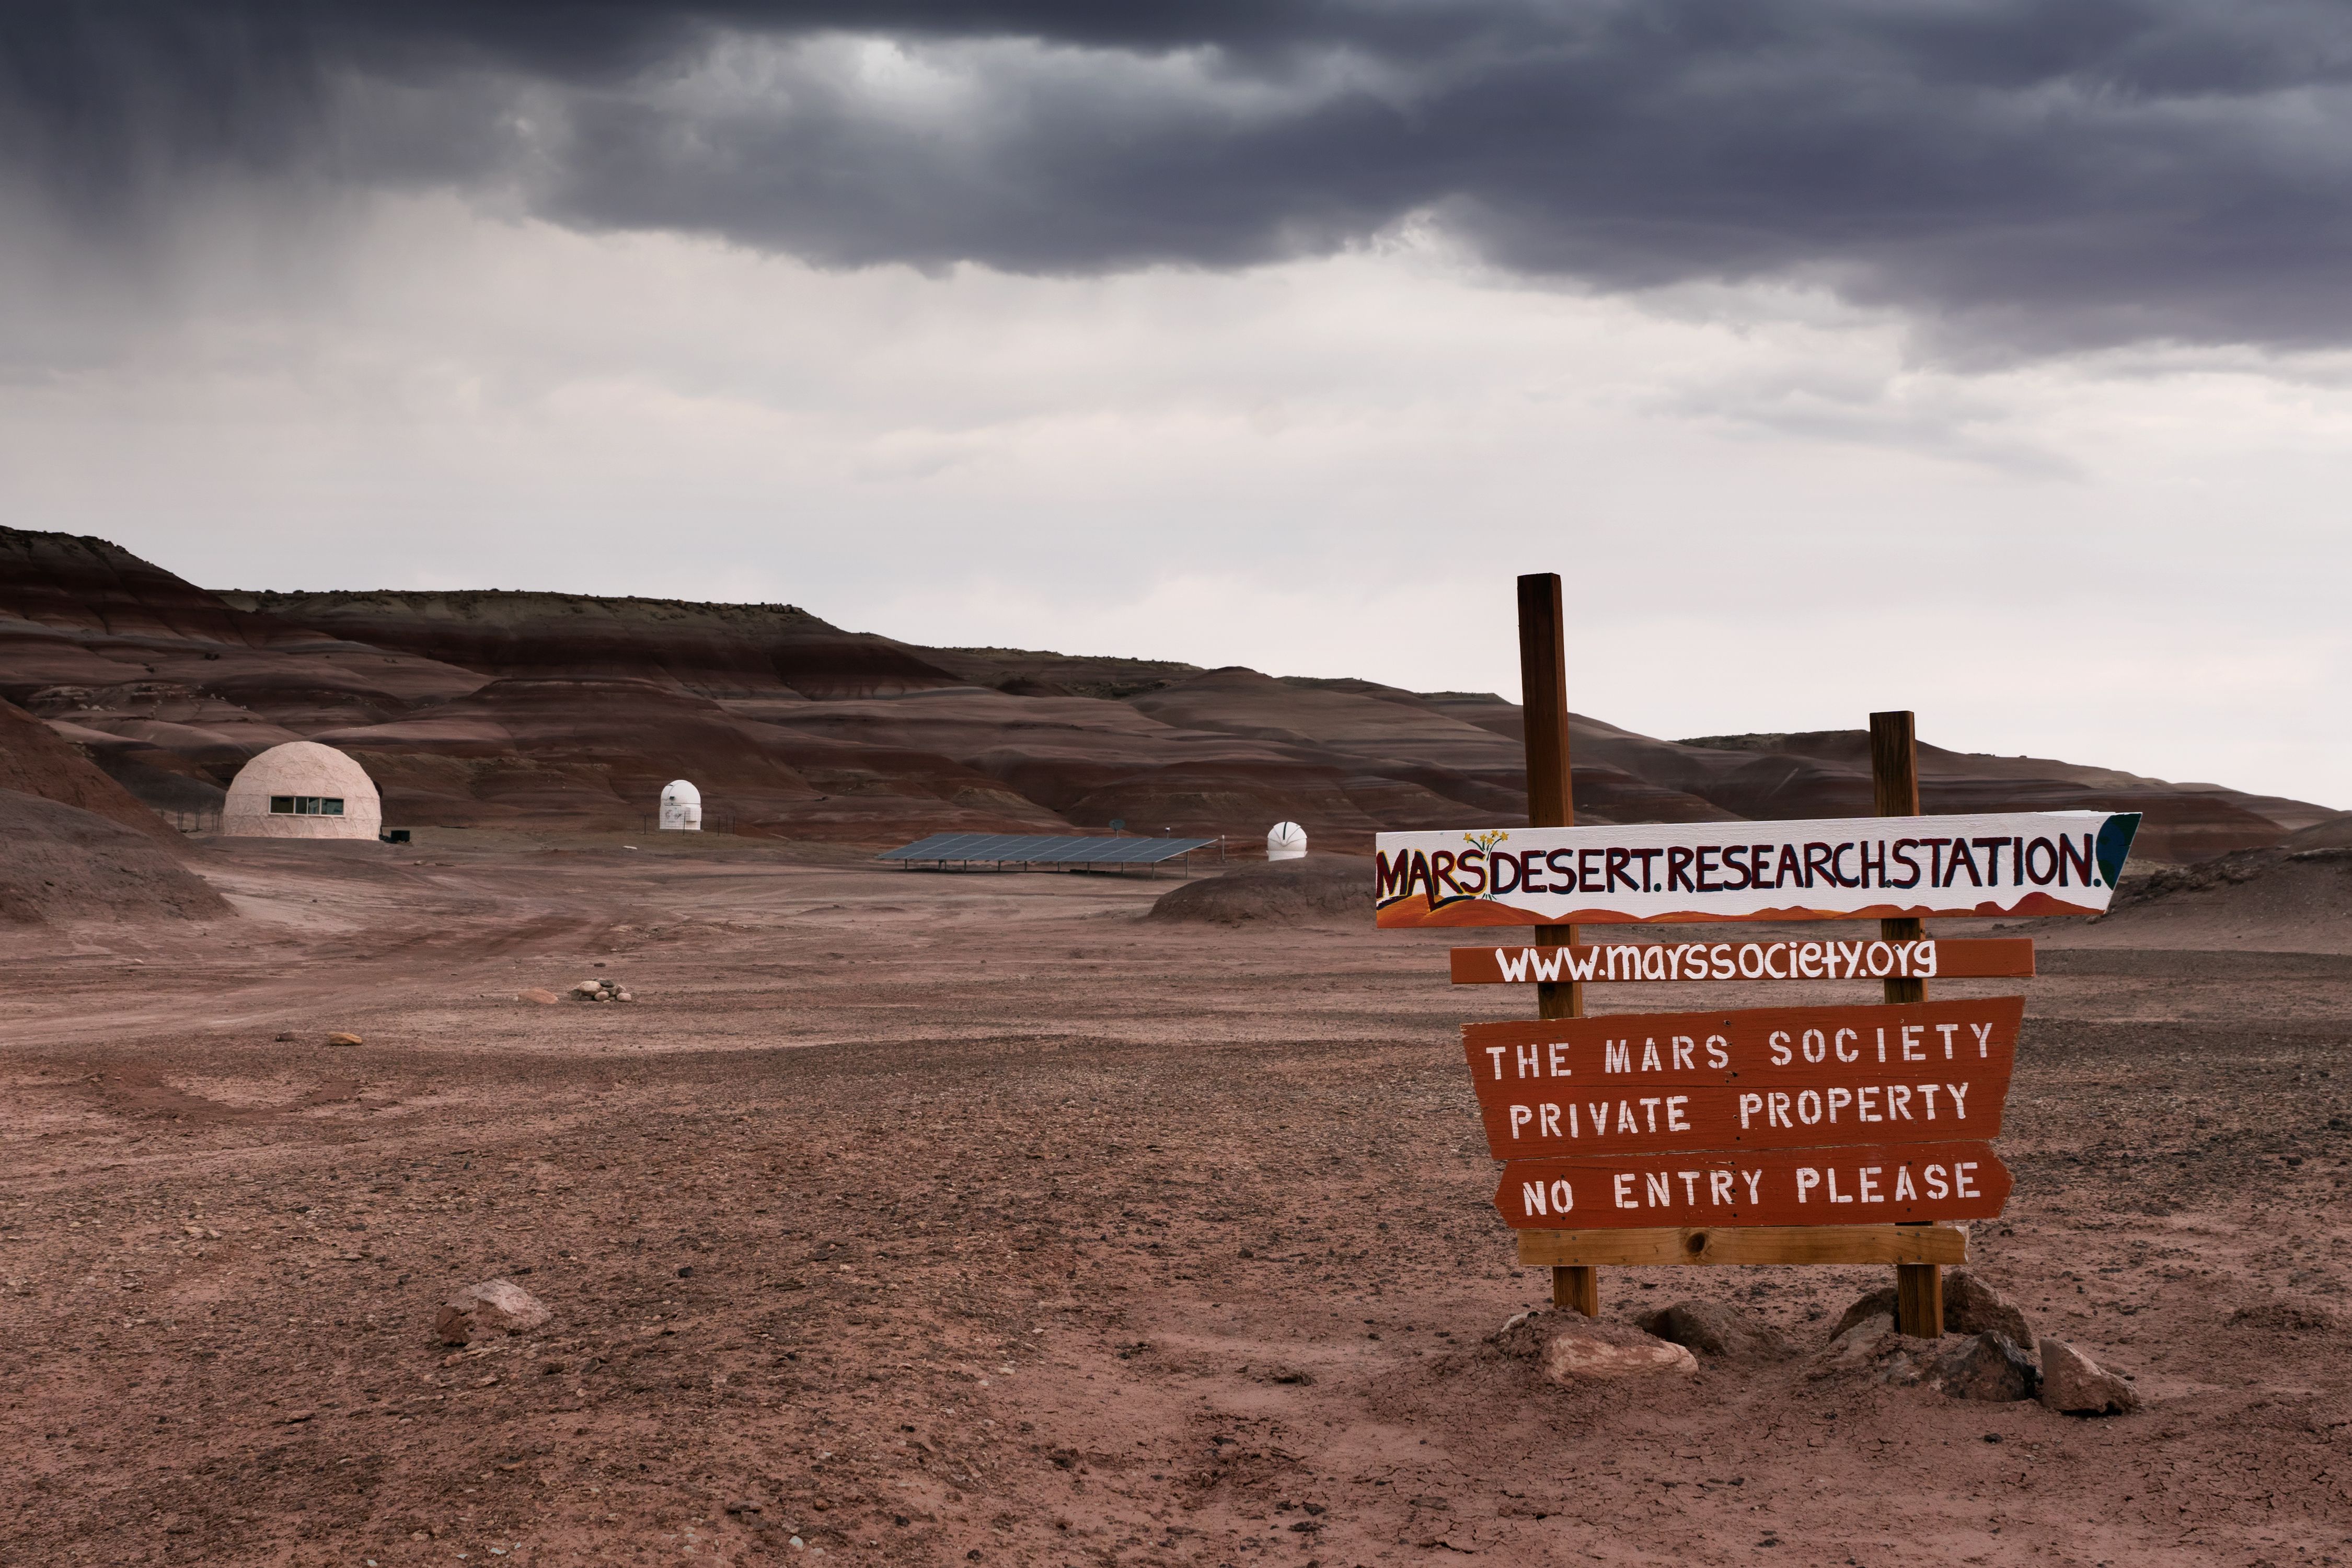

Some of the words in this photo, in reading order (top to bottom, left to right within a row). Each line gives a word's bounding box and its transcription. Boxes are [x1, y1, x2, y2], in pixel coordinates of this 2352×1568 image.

[1495, 940, 1937, 982] www.marssociety.org
[1486, 1043, 1571, 1080] THE
[1605, 1035, 1728, 1073] MARS
[1769, 1022, 1992, 1065] SOCIETY
[1509, 1096, 1691, 1139] PRIVATE
[1740, 1082, 1968, 1129] PROPERTY
[1523, 1180, 1573, 1216] NO
[1614, 1169, 1762, 1208] ENTRY
[1796, 1162, 1981, 1203] PLEASE
